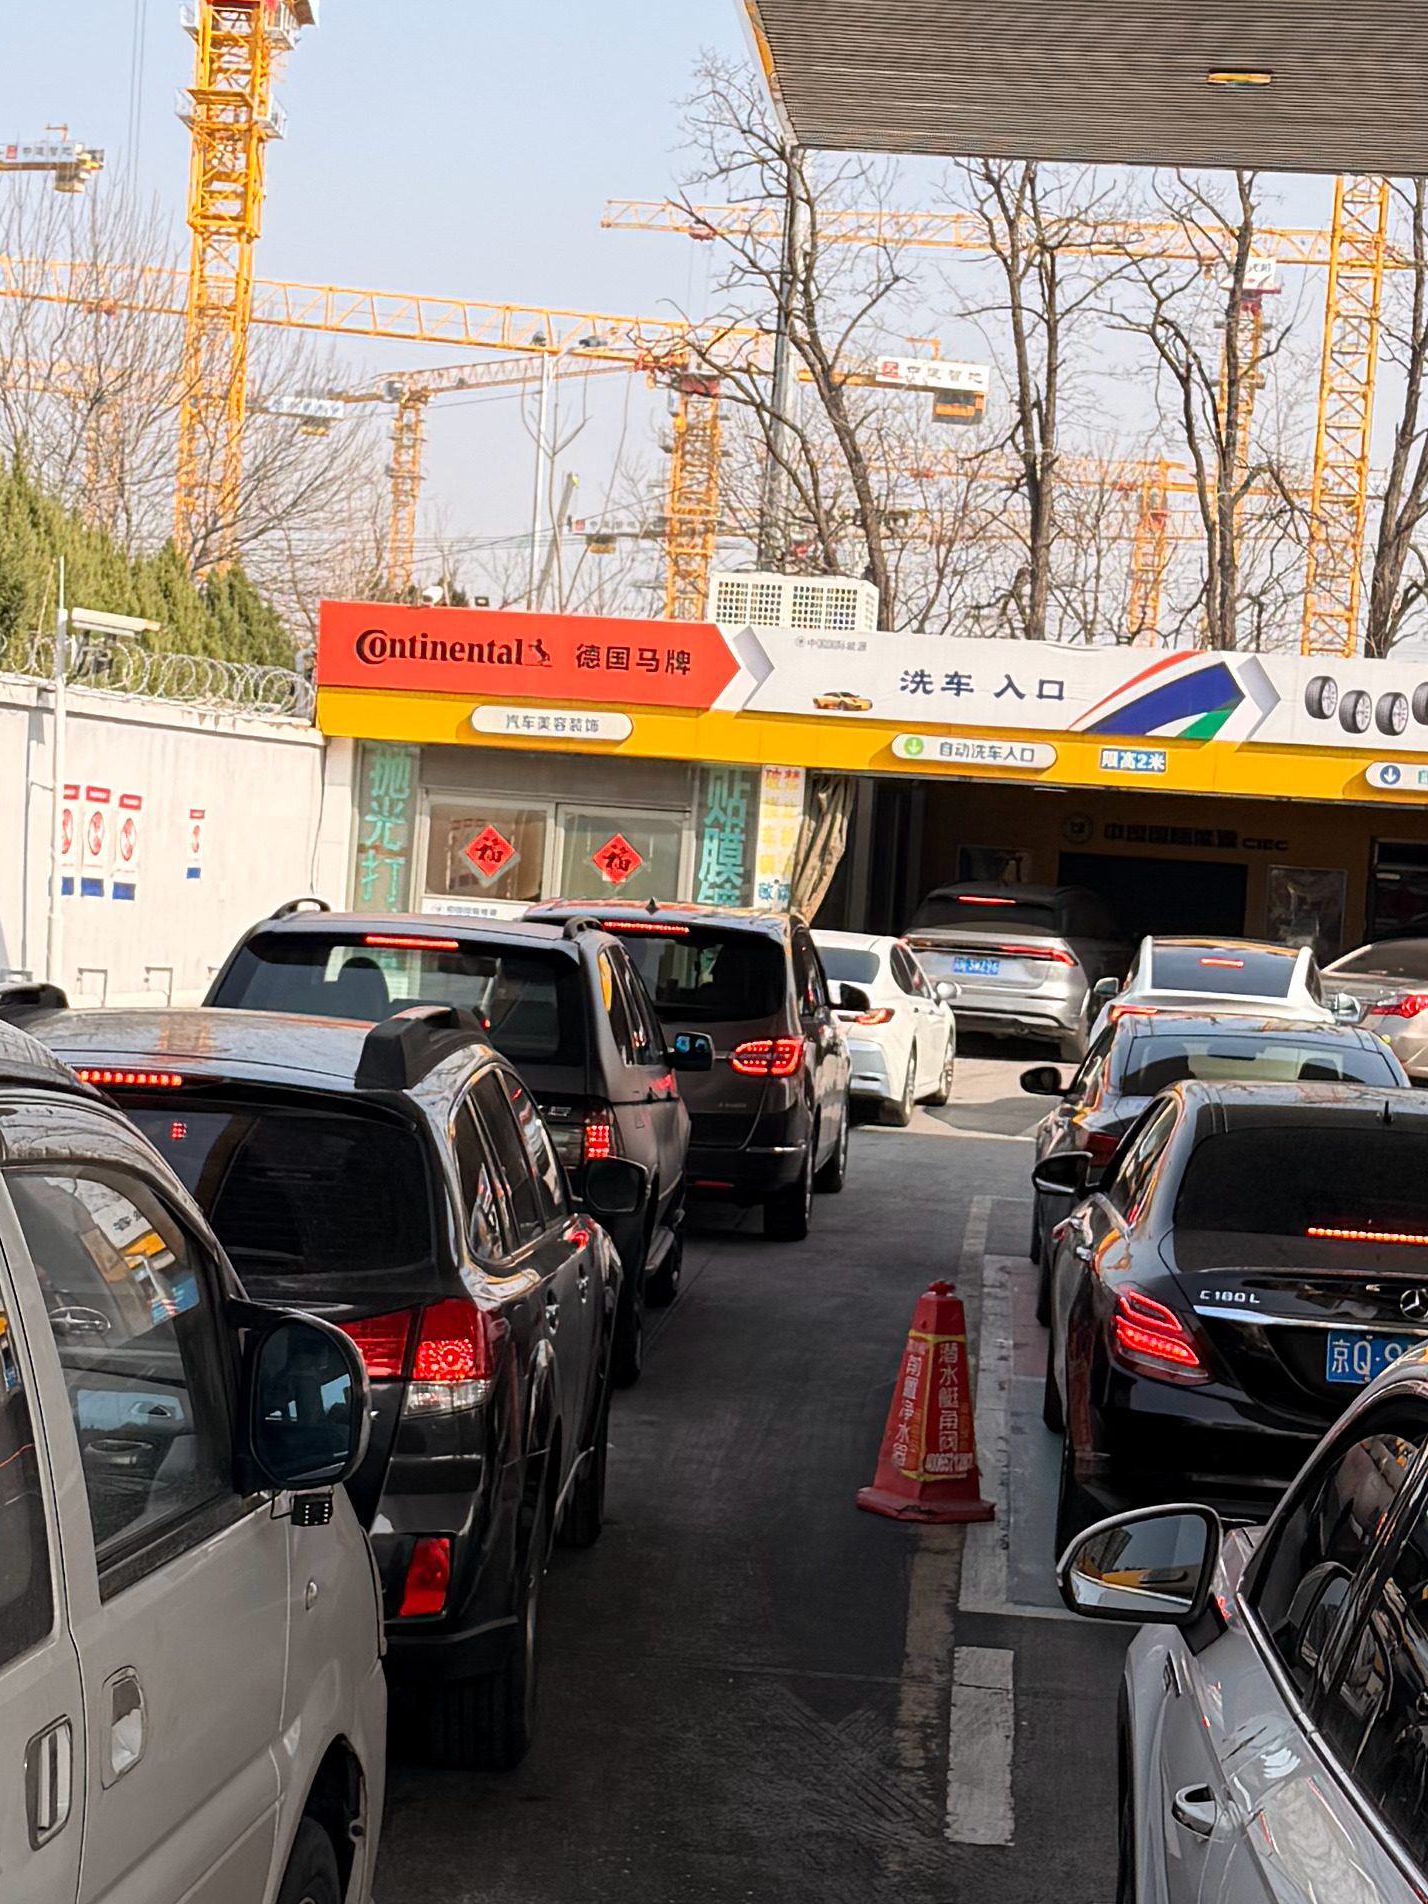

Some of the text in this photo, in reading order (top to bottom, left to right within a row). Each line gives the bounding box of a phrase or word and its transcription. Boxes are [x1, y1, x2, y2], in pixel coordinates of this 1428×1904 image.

[356, 629, 523, 666] Continental
[575, 642, 692, 675] 德国马牌
[938, 741, 1036, 764] 自动洗车入口
[1101, 749, 1166, 773] 限高2米
[361, 748, 412, 912] 抛光打
